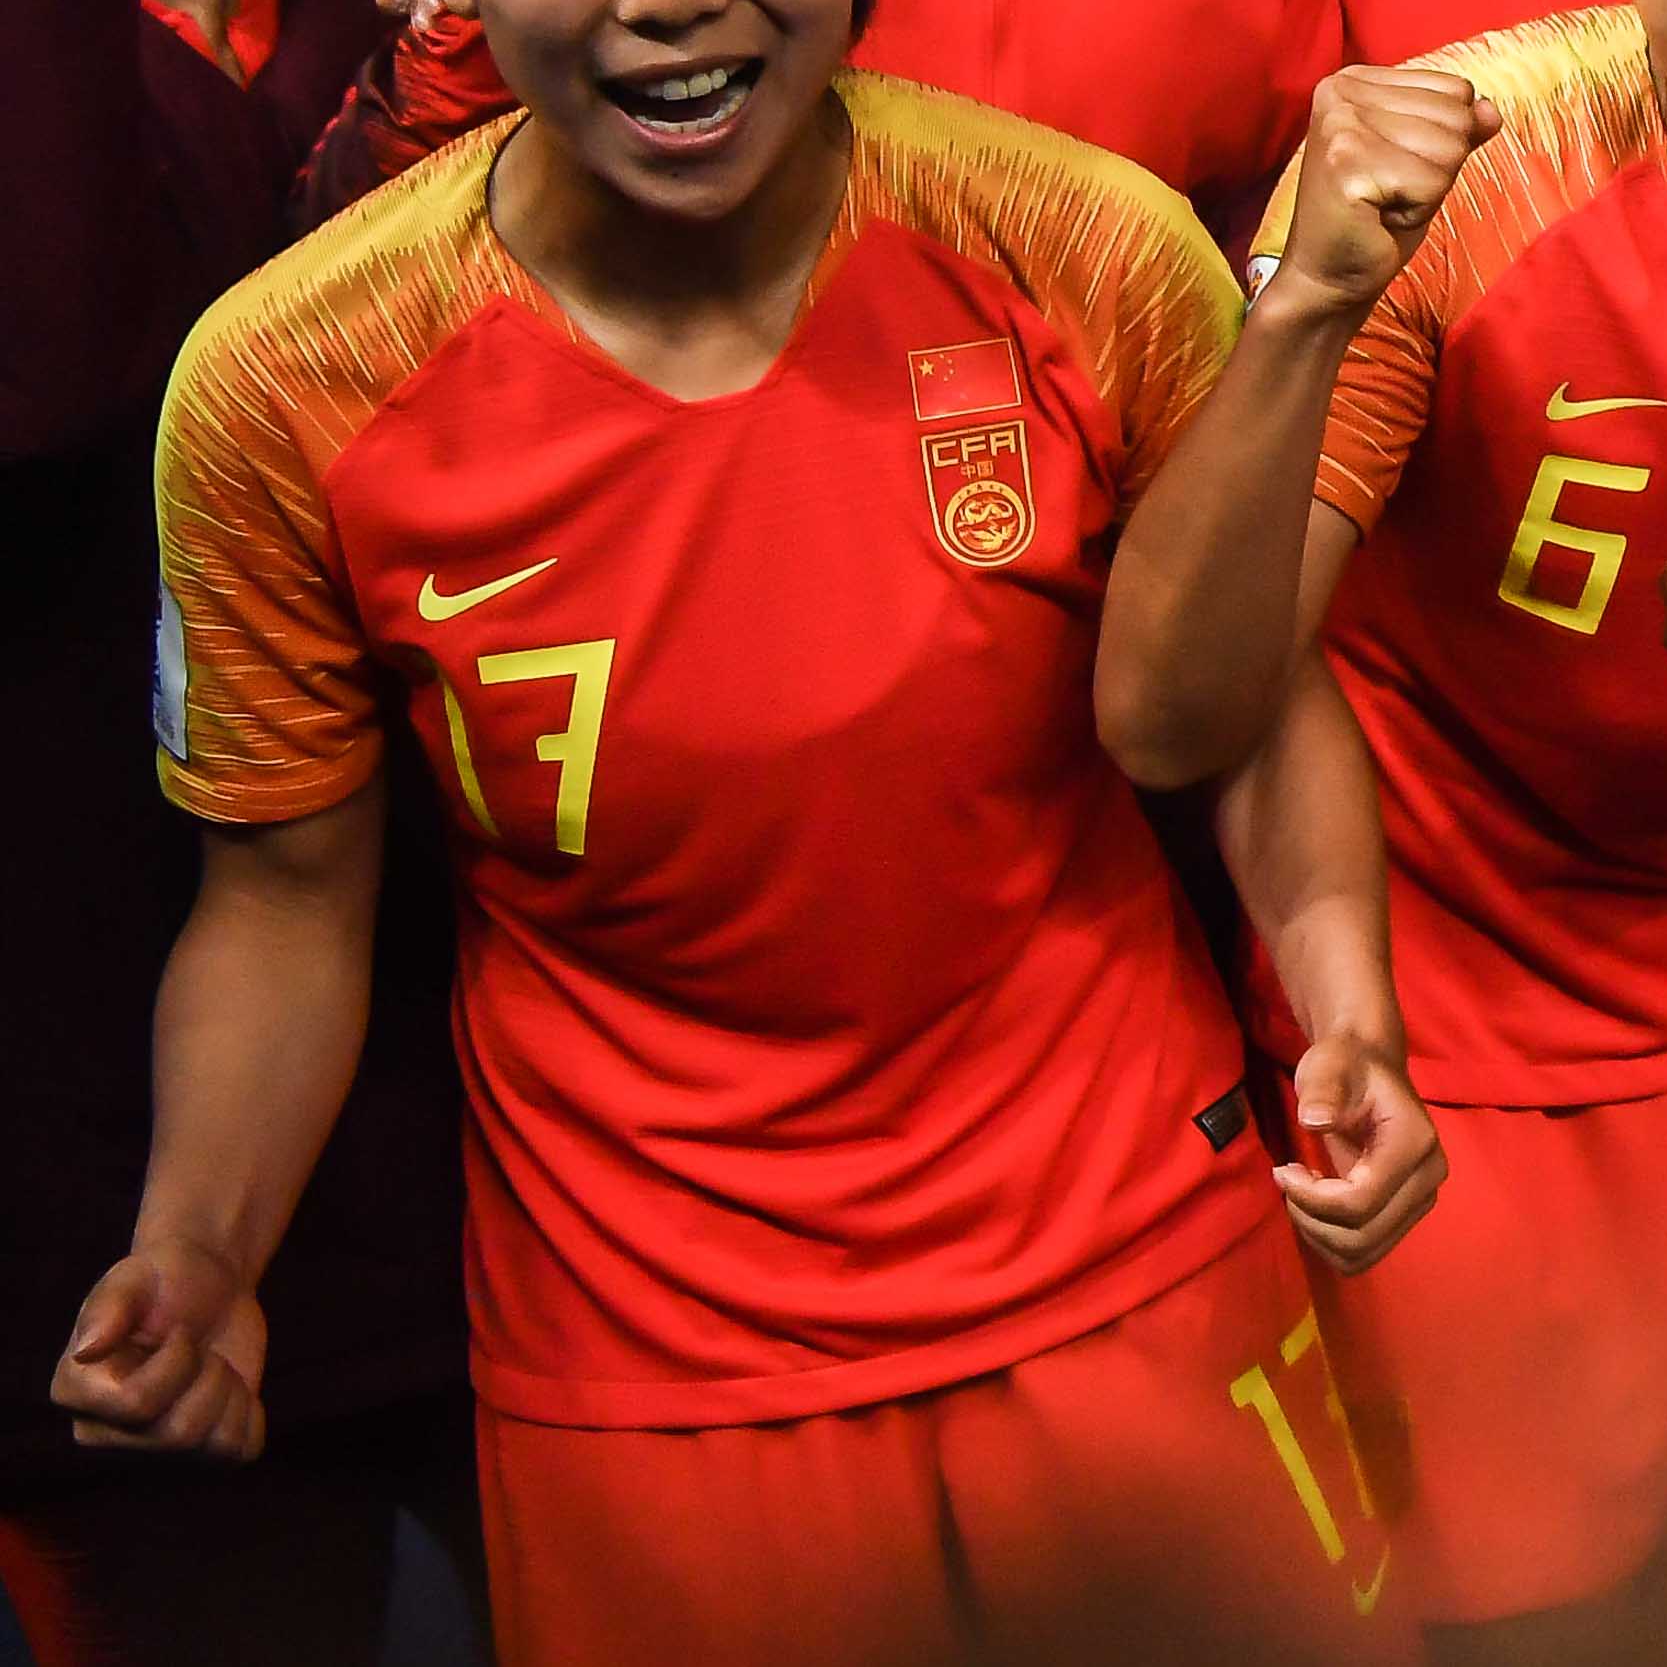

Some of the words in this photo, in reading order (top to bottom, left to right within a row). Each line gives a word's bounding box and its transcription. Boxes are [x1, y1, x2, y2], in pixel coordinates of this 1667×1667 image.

[931, 429, 1017, 469] CFA
[961, 460, 995, 479] 中国
[1498, 454, 1651, 635] 6
[438, 638, 617, 856] 17
